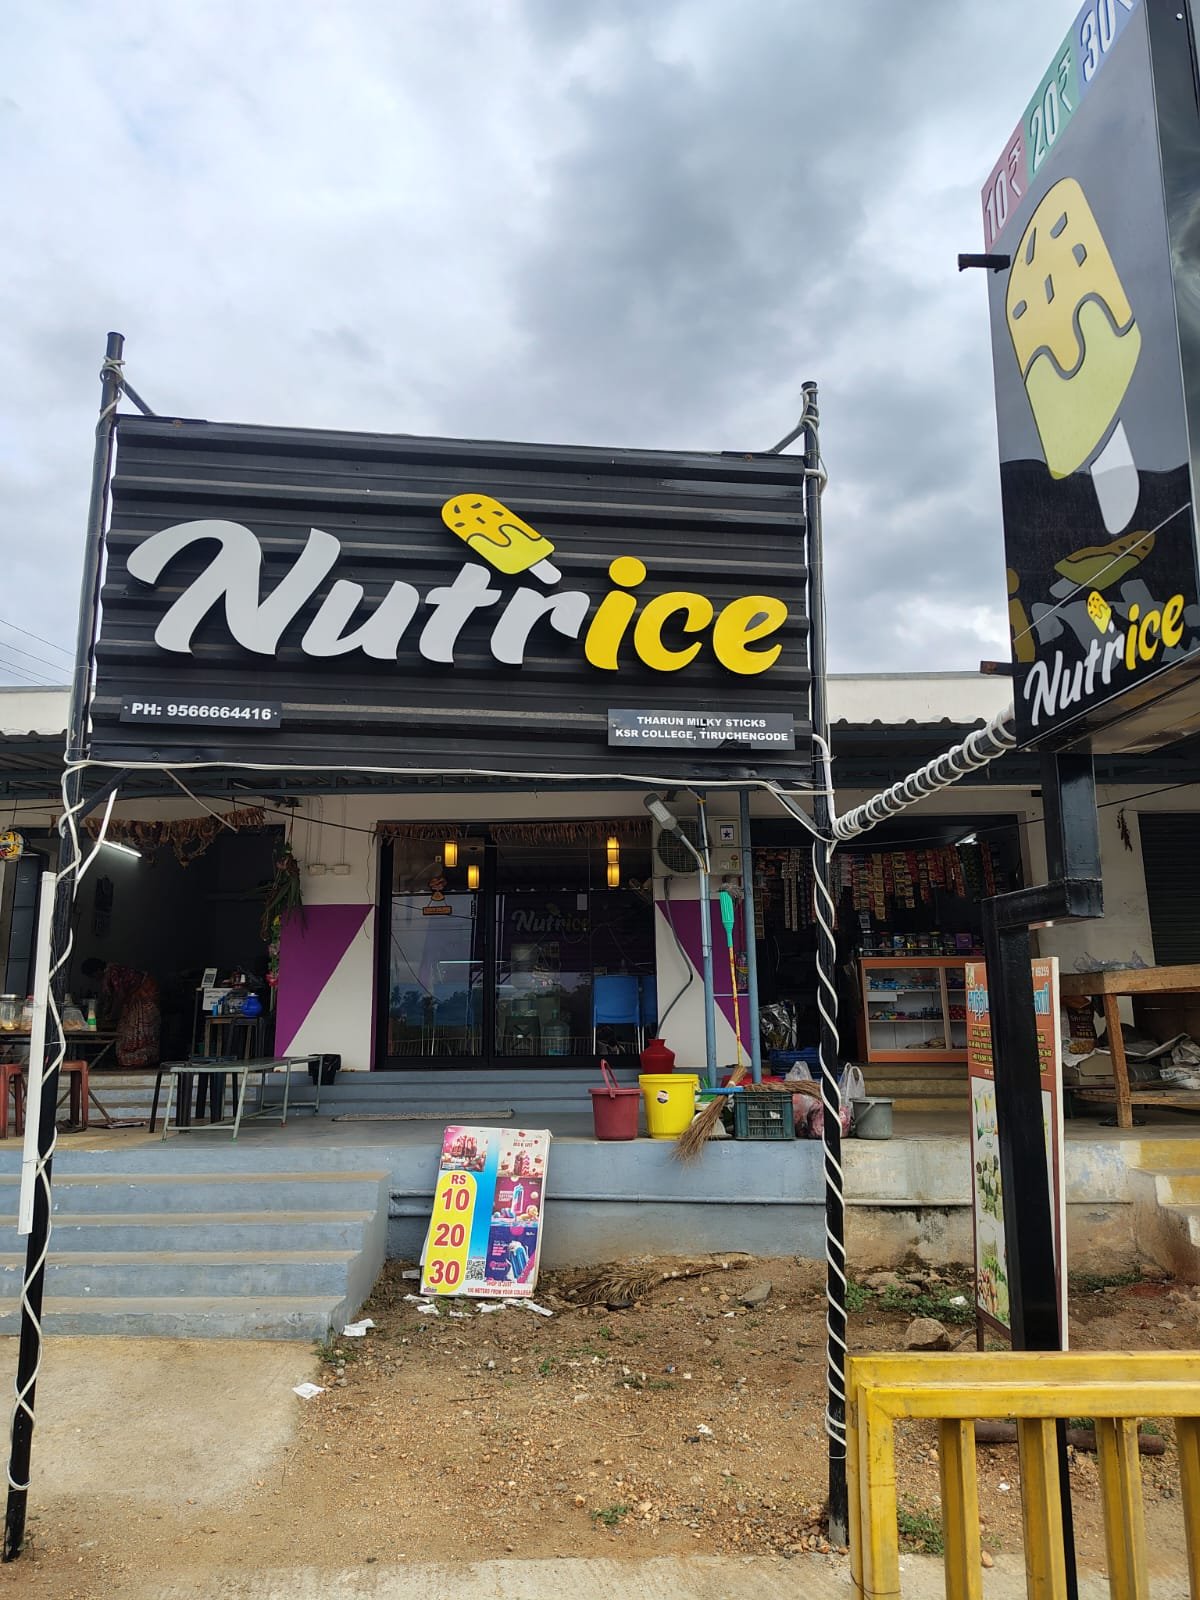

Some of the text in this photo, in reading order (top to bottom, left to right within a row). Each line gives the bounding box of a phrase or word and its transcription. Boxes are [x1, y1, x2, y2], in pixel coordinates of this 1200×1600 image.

[126, 519, 789, 675] Nutrice
[1023, 594, 1185, 727] Nutrice
[131, 702, 272, 721] PH: 9566664416
[637, 716, 766, 728] THARUN MILKY STICKS
[615, 729, 788, 741] KSR COLLEGE, TIRUCHENGODE
[451, 1174, 466, 1185] RS
[442, 1188, 470, 1211] 10
[434, 1223, 465, 1247] 20
[429, 1260, 460, 1285] 30
